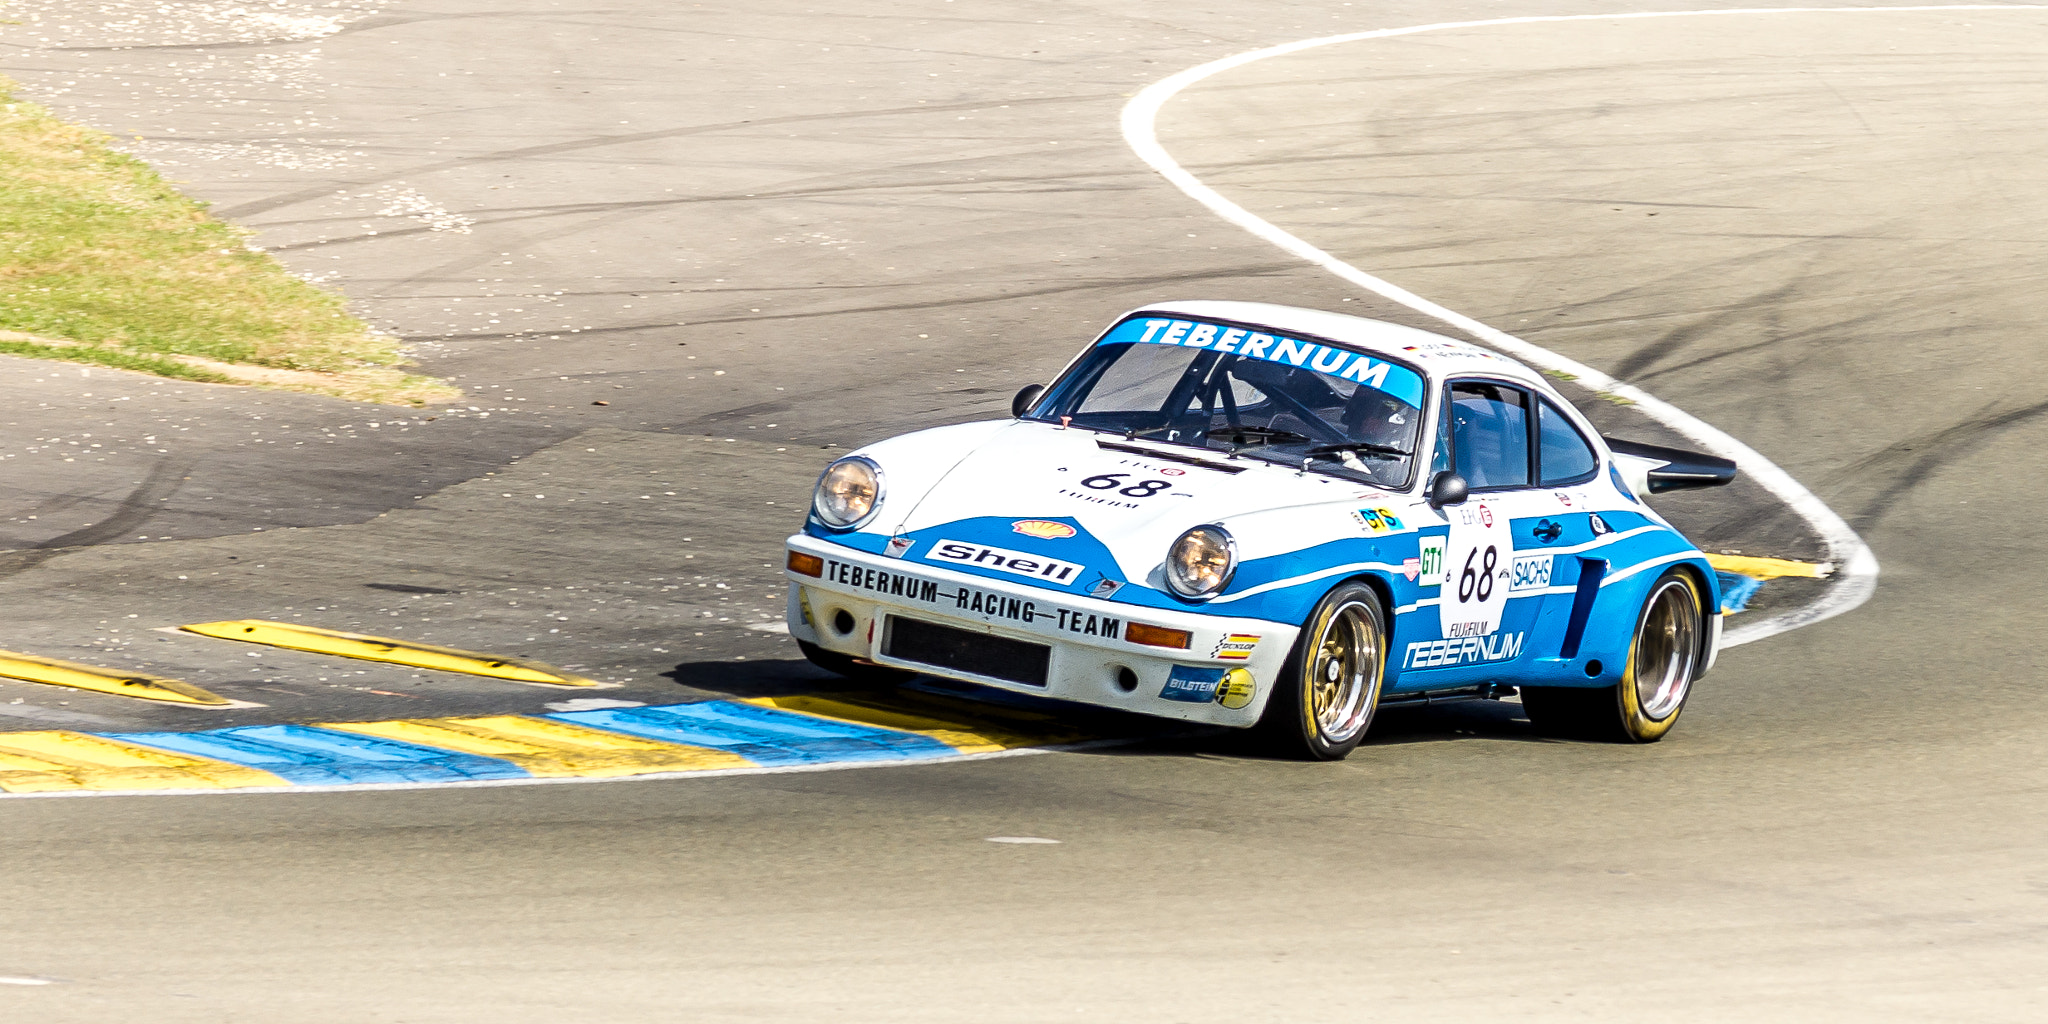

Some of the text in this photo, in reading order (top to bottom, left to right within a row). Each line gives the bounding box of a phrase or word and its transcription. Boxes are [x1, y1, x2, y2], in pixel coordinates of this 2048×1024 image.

[1139, 319, 1391, 389] TEBERNUM
[1080, 473, 1173, 498] 68
[938, 544, 1073, 581] Shell
[1422, 547, 1442, 575] GT1
[1458, 545, 1497, 603] 68
[1513, 559, 1551, 587] SACHS
[1449, 621, 1488, 638] FUJIFILM
[1402, 631, 1524, 669] TEBERNUM
[1169, 678, 1219, 692] BILSTEIN
